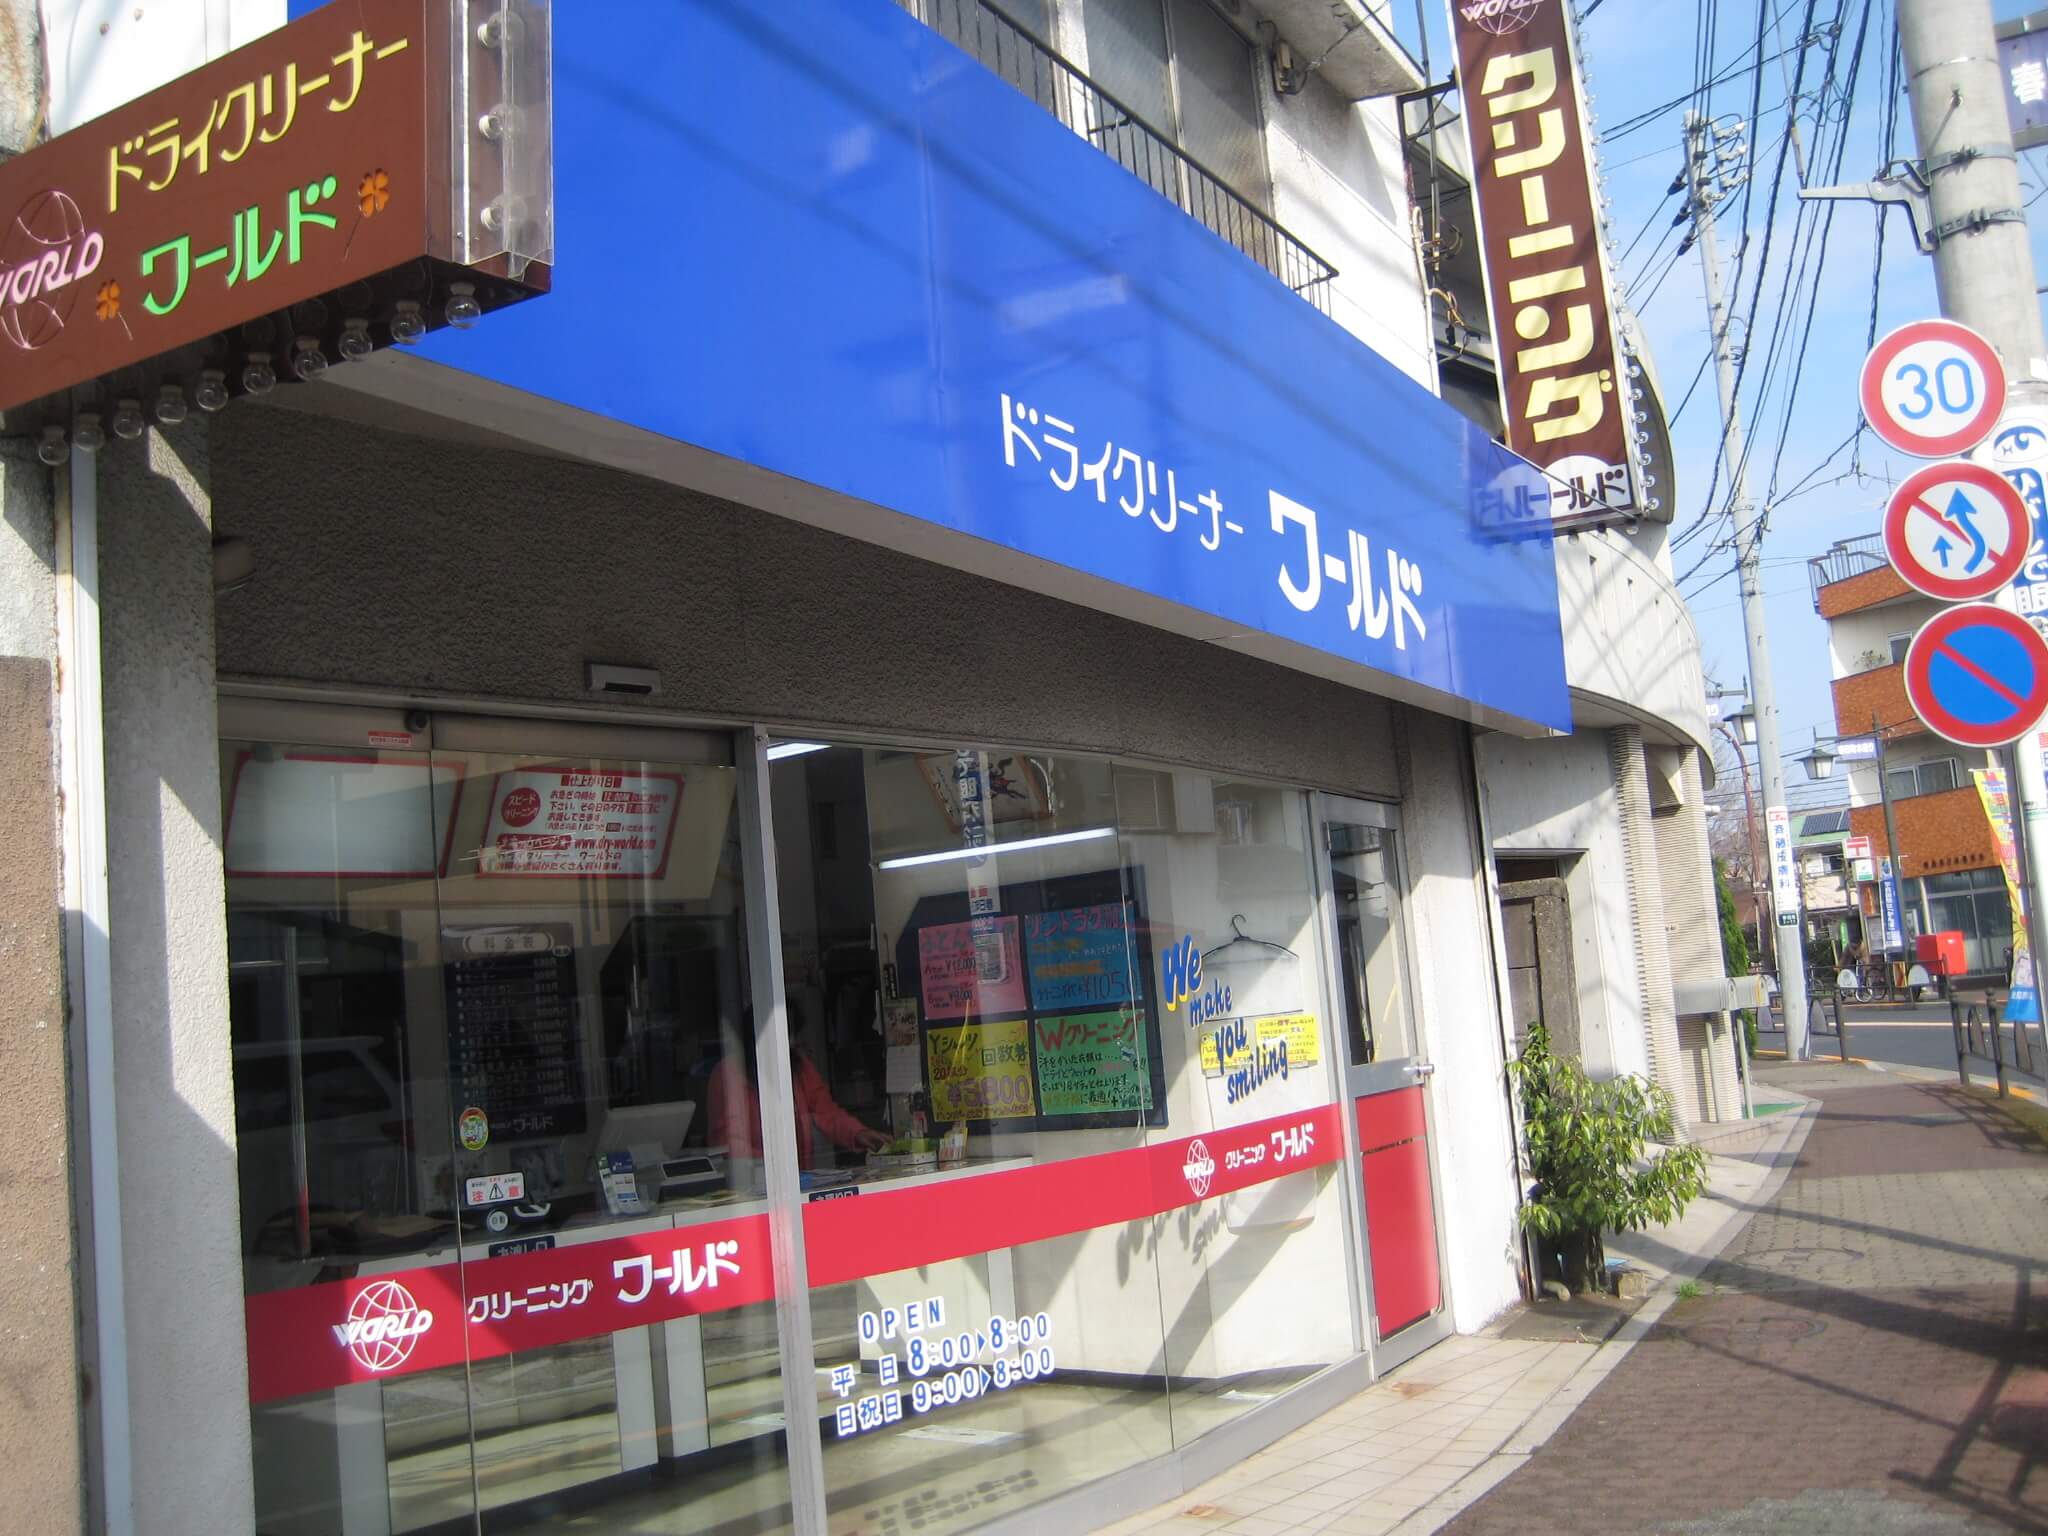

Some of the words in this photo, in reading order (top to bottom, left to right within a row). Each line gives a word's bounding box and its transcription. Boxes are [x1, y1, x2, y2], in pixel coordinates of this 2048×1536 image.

[109, 31, 408, 212] ドライクリーナー
[142, 175, 337, 314] ワールド
[1481, 47, 1613, 443] クリーニング
[1896, 358, 1975, 420] 30
[1548, 469, 1627, 511] ールド
[1001, 393, 1243, 551] ドライクリーナー
[1268, 489, 1426, 650] ワールド
[1163, 935, 1203, 1012] We
[1190, 978, 1232, 1028] make
[1214, 1017, 1249, 1076] you
[1227, 1038, 1290, 1105] smiling
[1183, 1158, 1215, 1179] WORLD
[1225, 1144, 1266, 1169] クリーニング
[1271, 1121, 1315, 1162] ワールド
[468, 1278, 594, 1324] クリーニング
[613, 1240, 740, 1305] ワールド
[332, 1309, 434, 1348] WORLD
[860, 1296, 944, 1344] OPEN
[836, 1389, 902, 1437] 日祝日
